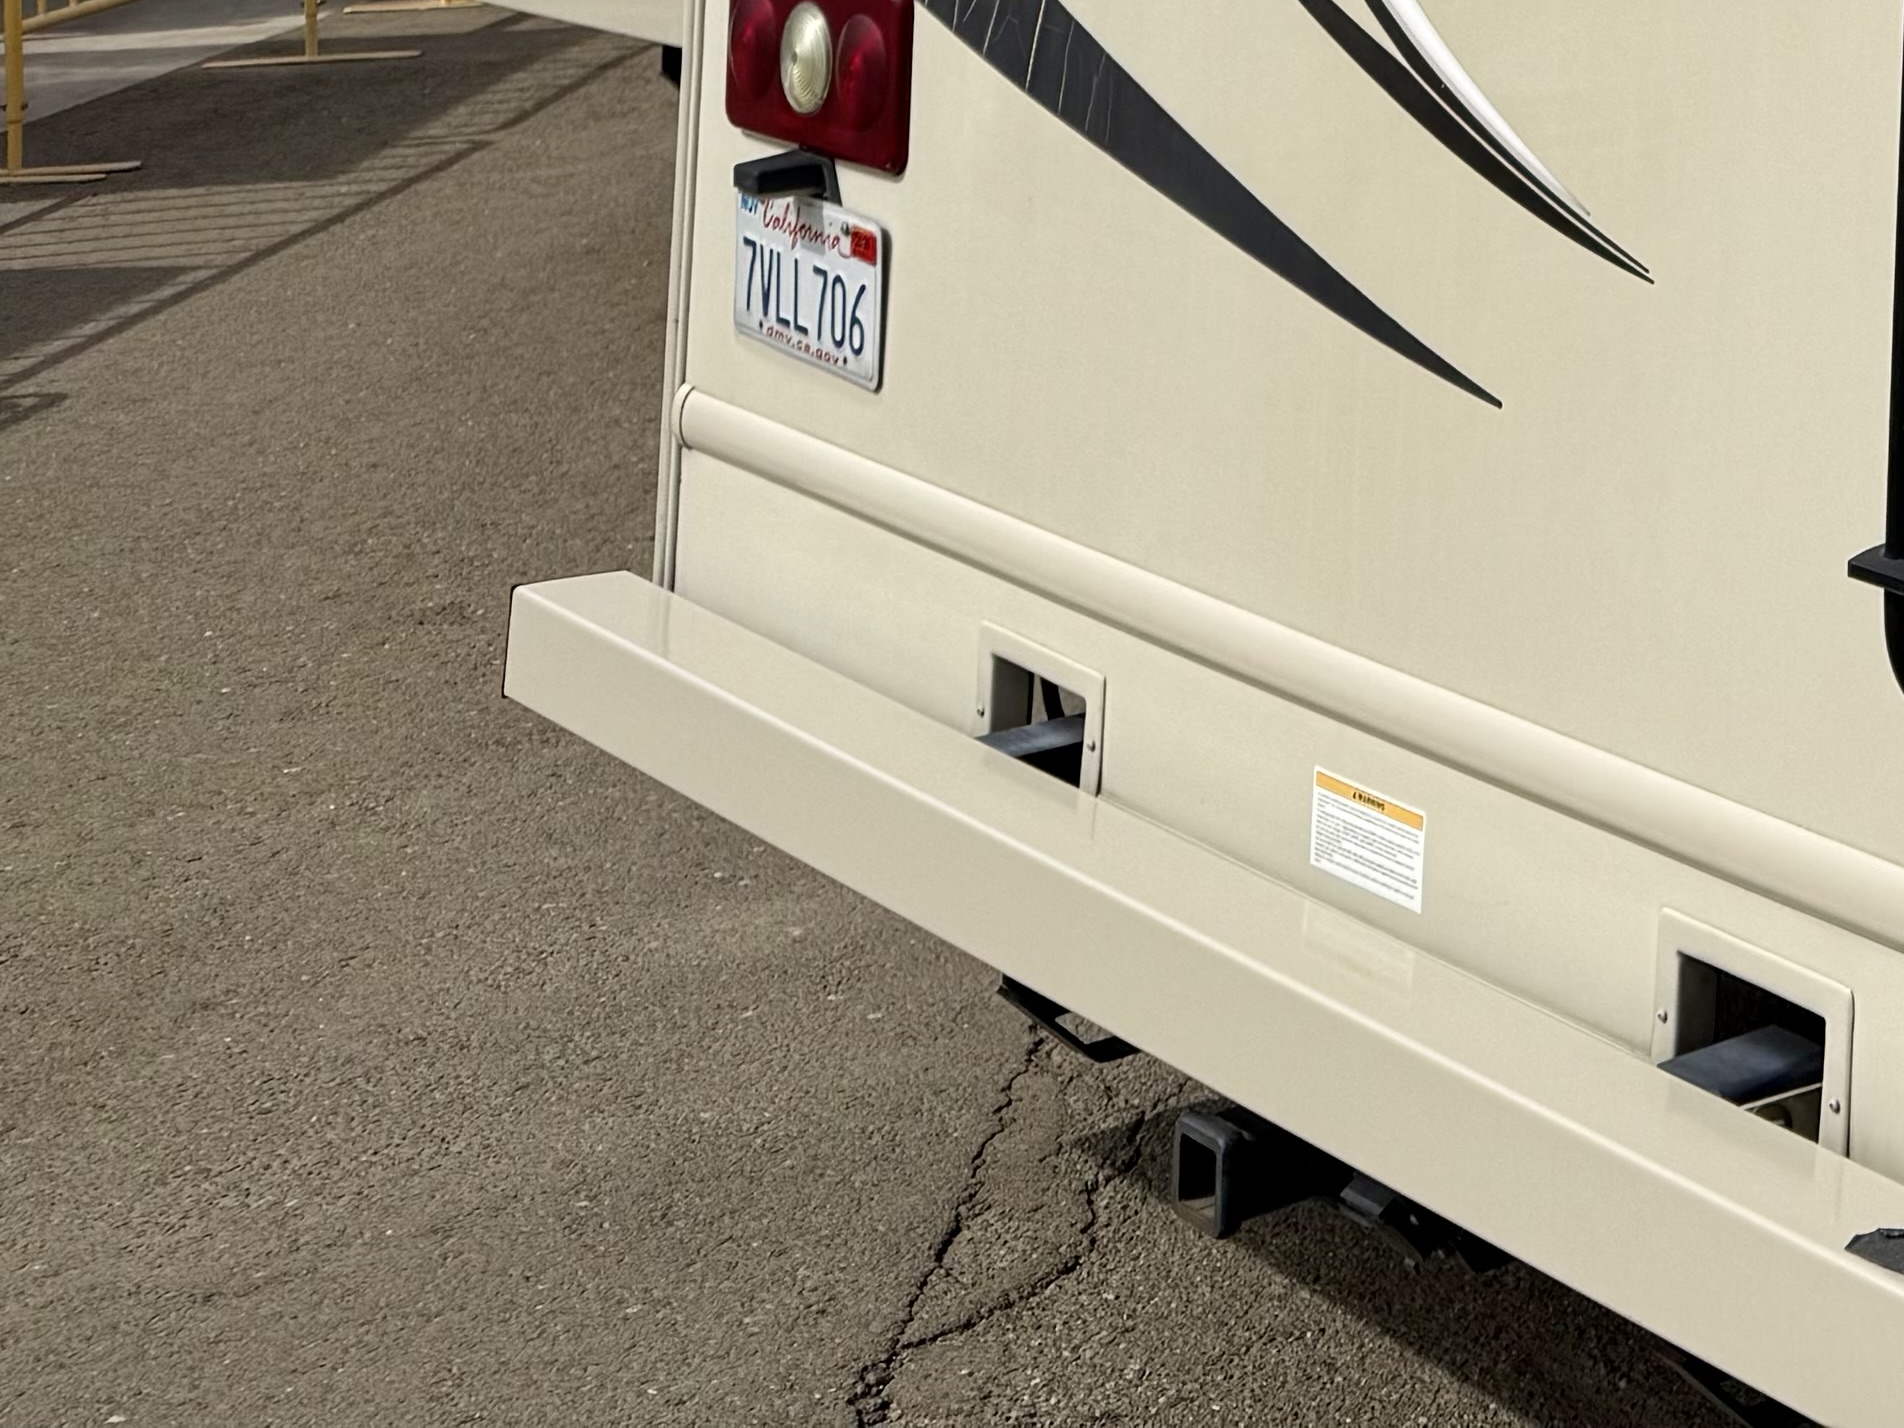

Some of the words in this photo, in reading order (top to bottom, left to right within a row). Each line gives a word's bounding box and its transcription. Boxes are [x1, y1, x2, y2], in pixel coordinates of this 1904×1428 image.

[760, 198, 841, 252] California
[743, 236, 867, 357] 7VLL706
[765, 326, 840, 366] dmv.ca.gov
